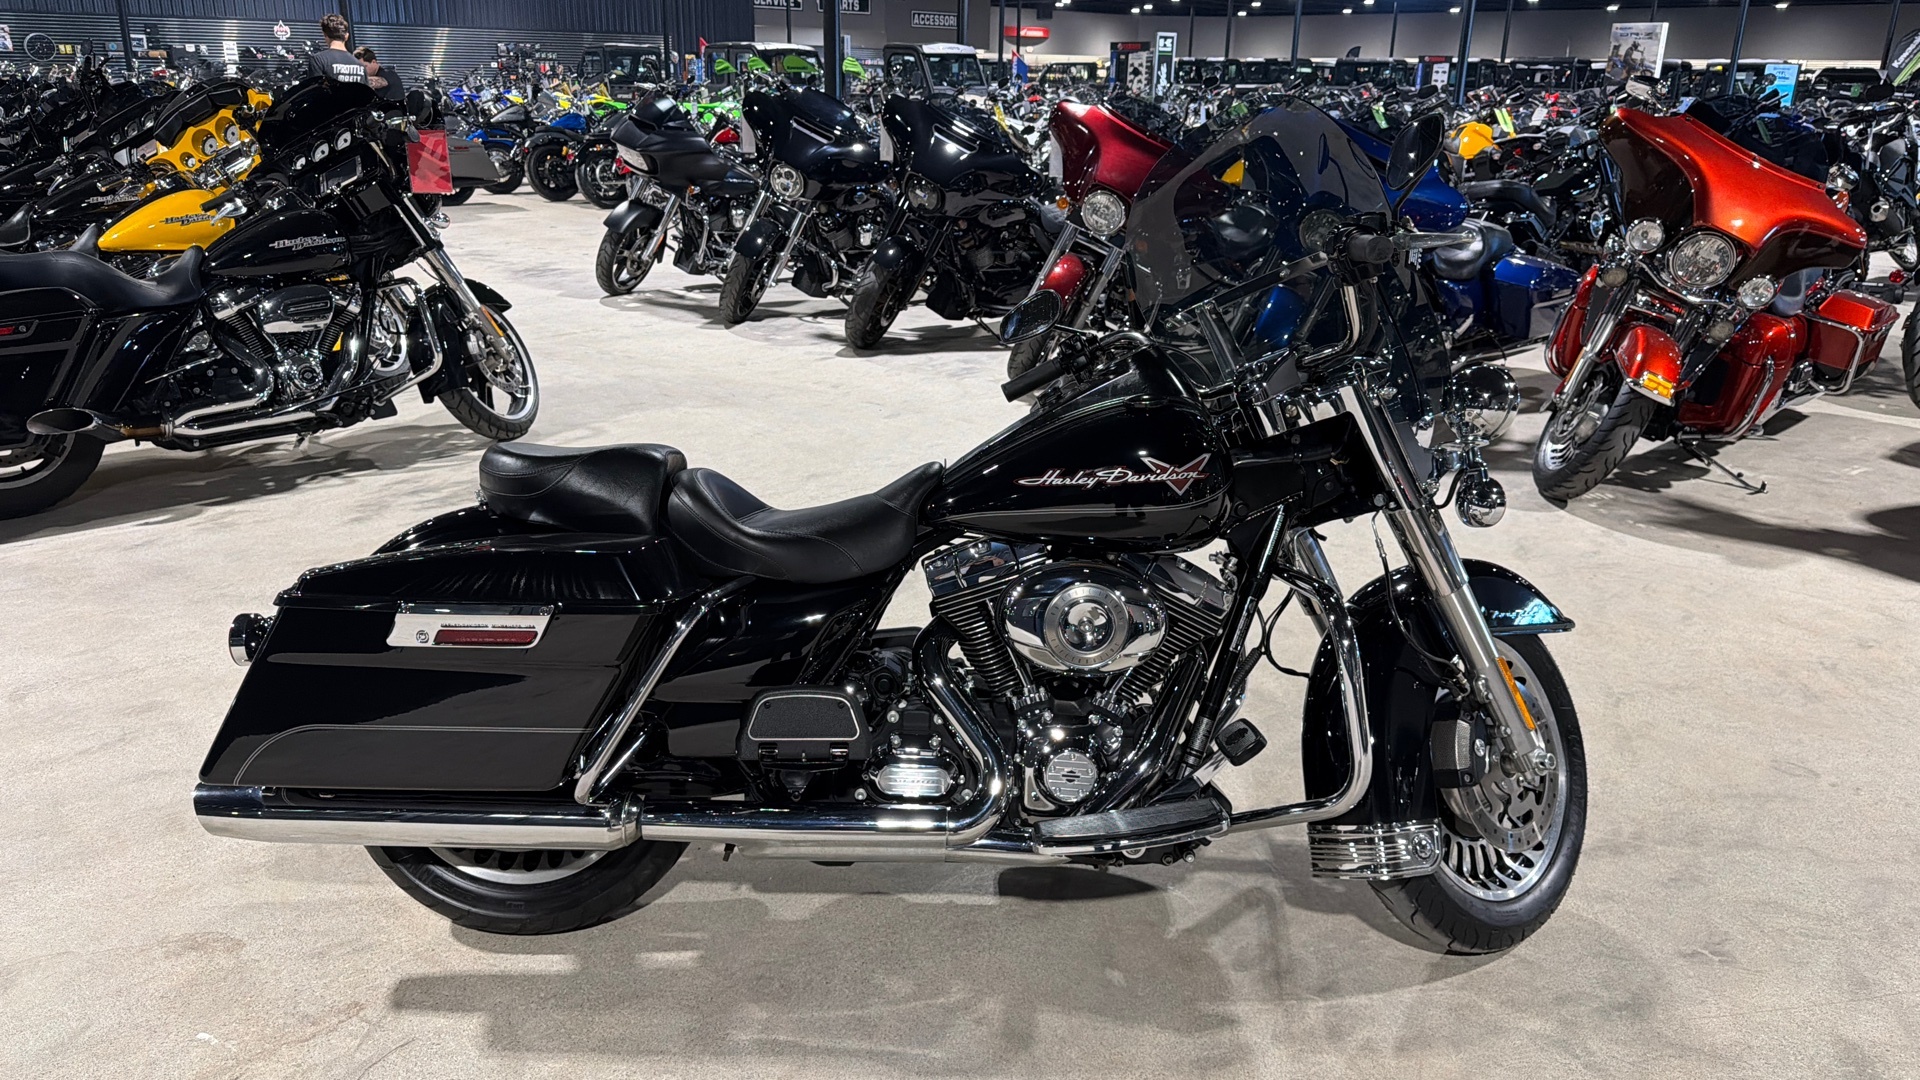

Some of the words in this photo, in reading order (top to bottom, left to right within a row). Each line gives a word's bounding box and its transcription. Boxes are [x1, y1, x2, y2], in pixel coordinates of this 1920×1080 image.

[913, 14, 957, 27] ACCESSORI
[332, 64, 364, 75] THROTTLE
[1017, 466, 1206, 491] Harley-Davidson
